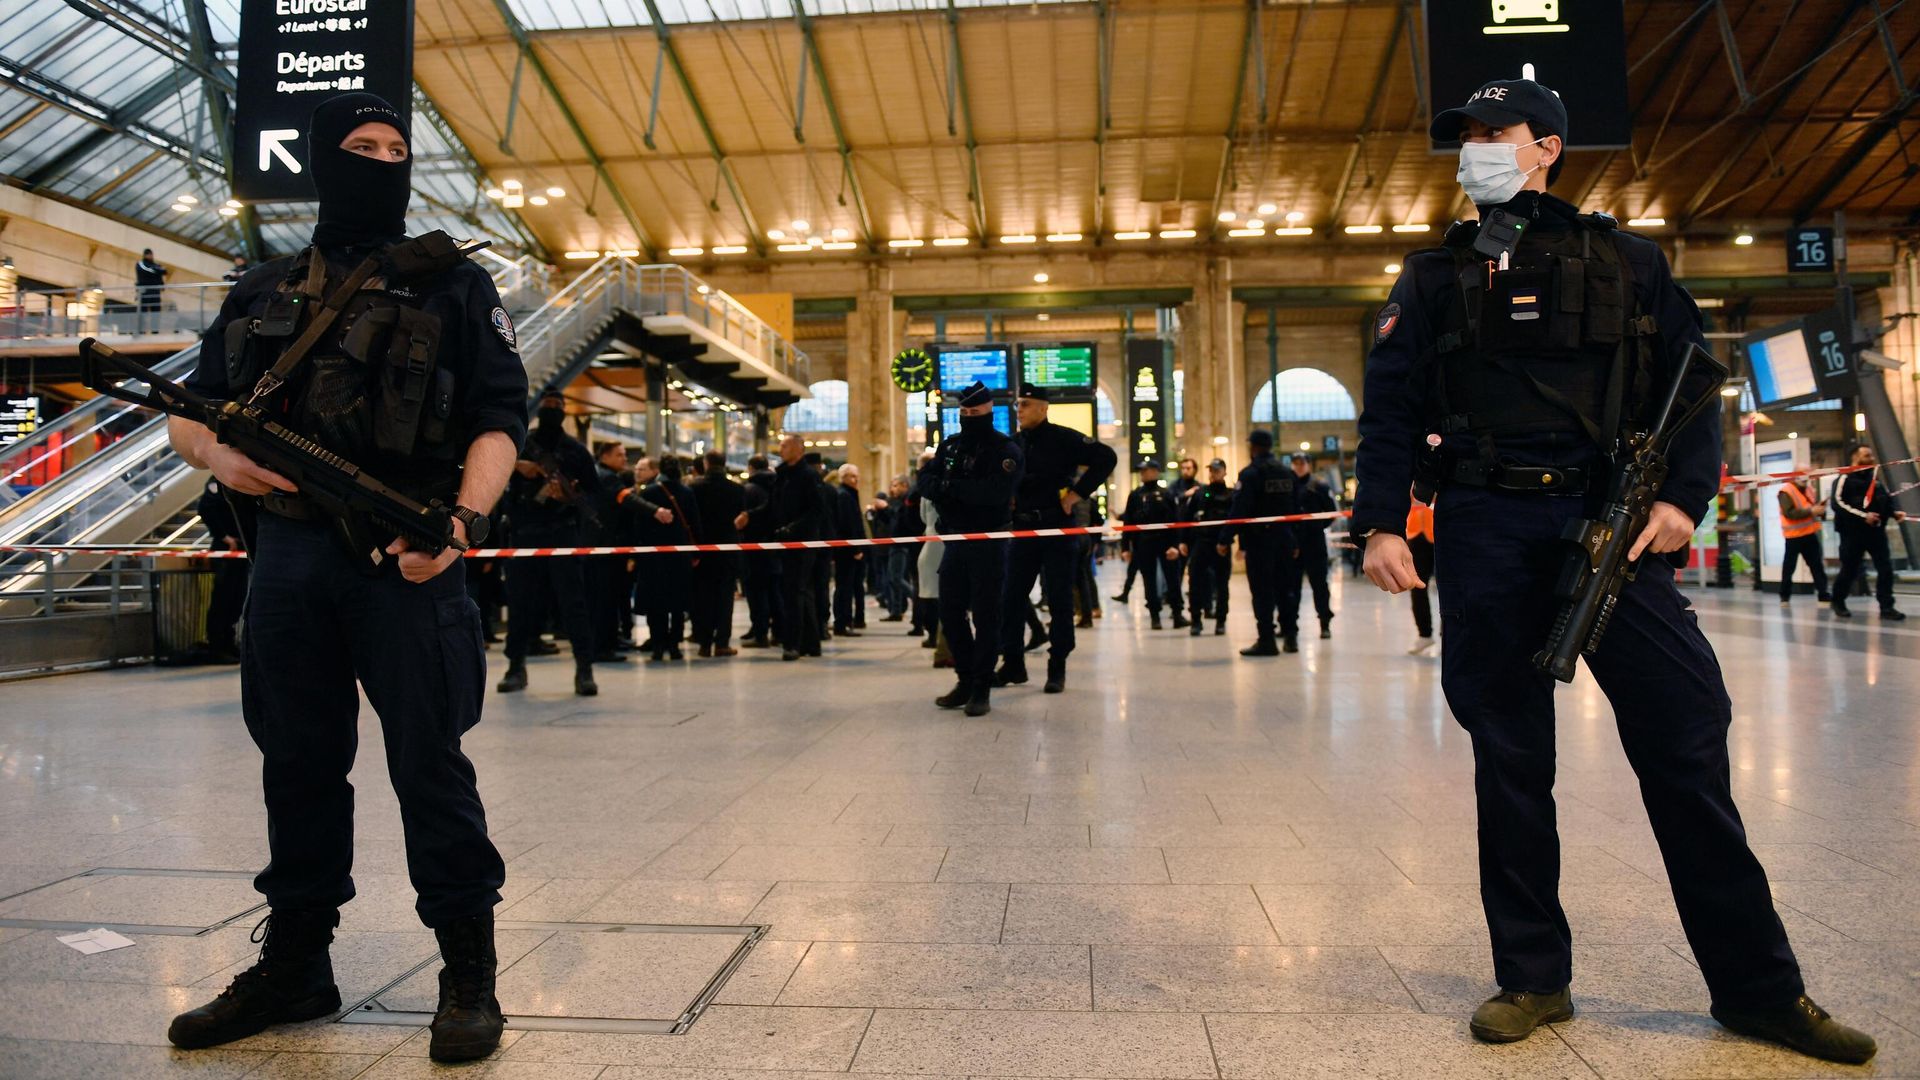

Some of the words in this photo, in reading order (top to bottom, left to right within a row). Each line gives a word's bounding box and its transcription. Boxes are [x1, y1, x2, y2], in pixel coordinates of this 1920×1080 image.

[276, 0, 367, 15] Eurostar
[291, 20, 318, 33] Level
[277, 51, 365, 77] Départs
[277, 80, 330, 93] Departures
[1467, 86, 1509, 104] OLICE
[1796, 242, 1826, 262] 16
[1821, 343, 1845, 370] 16
